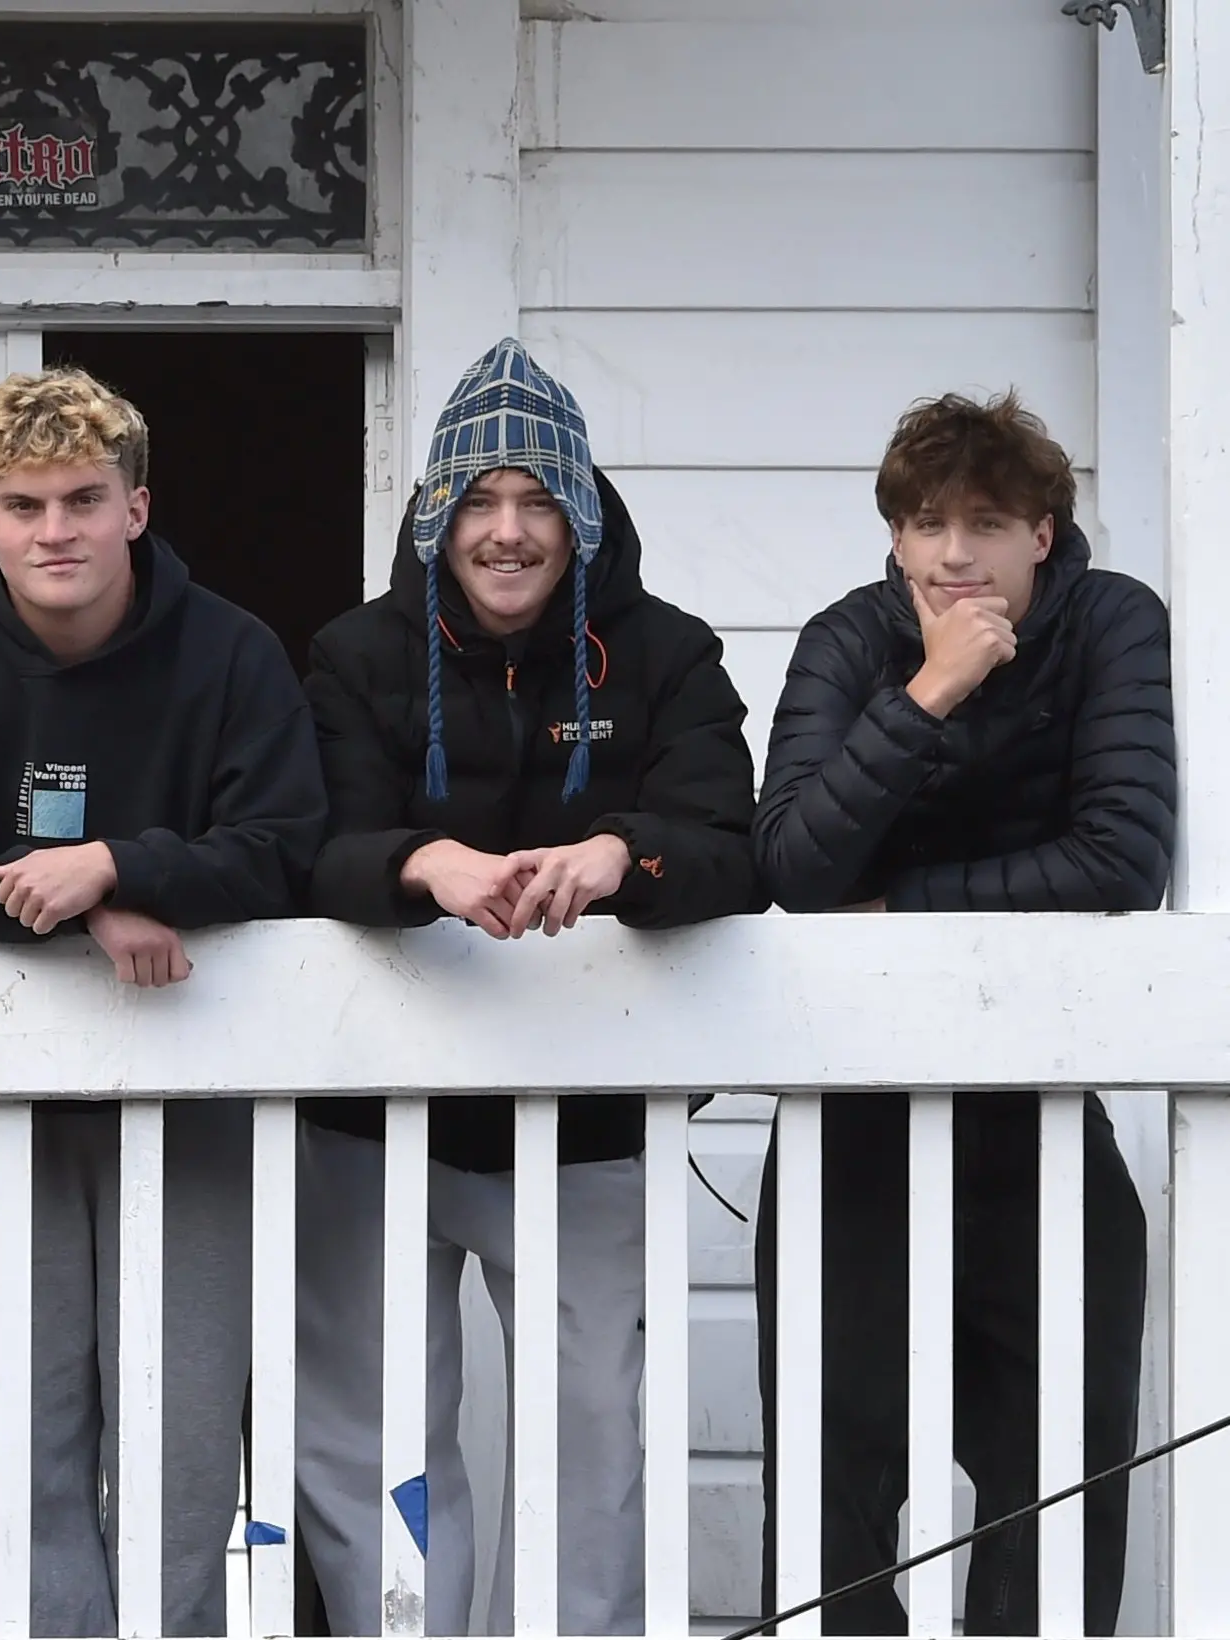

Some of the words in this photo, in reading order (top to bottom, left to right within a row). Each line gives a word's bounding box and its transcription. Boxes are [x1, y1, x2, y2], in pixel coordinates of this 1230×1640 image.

[16, 193, 60, 206] YOU'RE
[64, 192, 96, 205] DEAD
[562, 720, 613, 731] HUERS
[45, 763, 86, 773] Vincent
[34, 771, 58, 780] Van
[59, 773, 86, 781] Gogh
